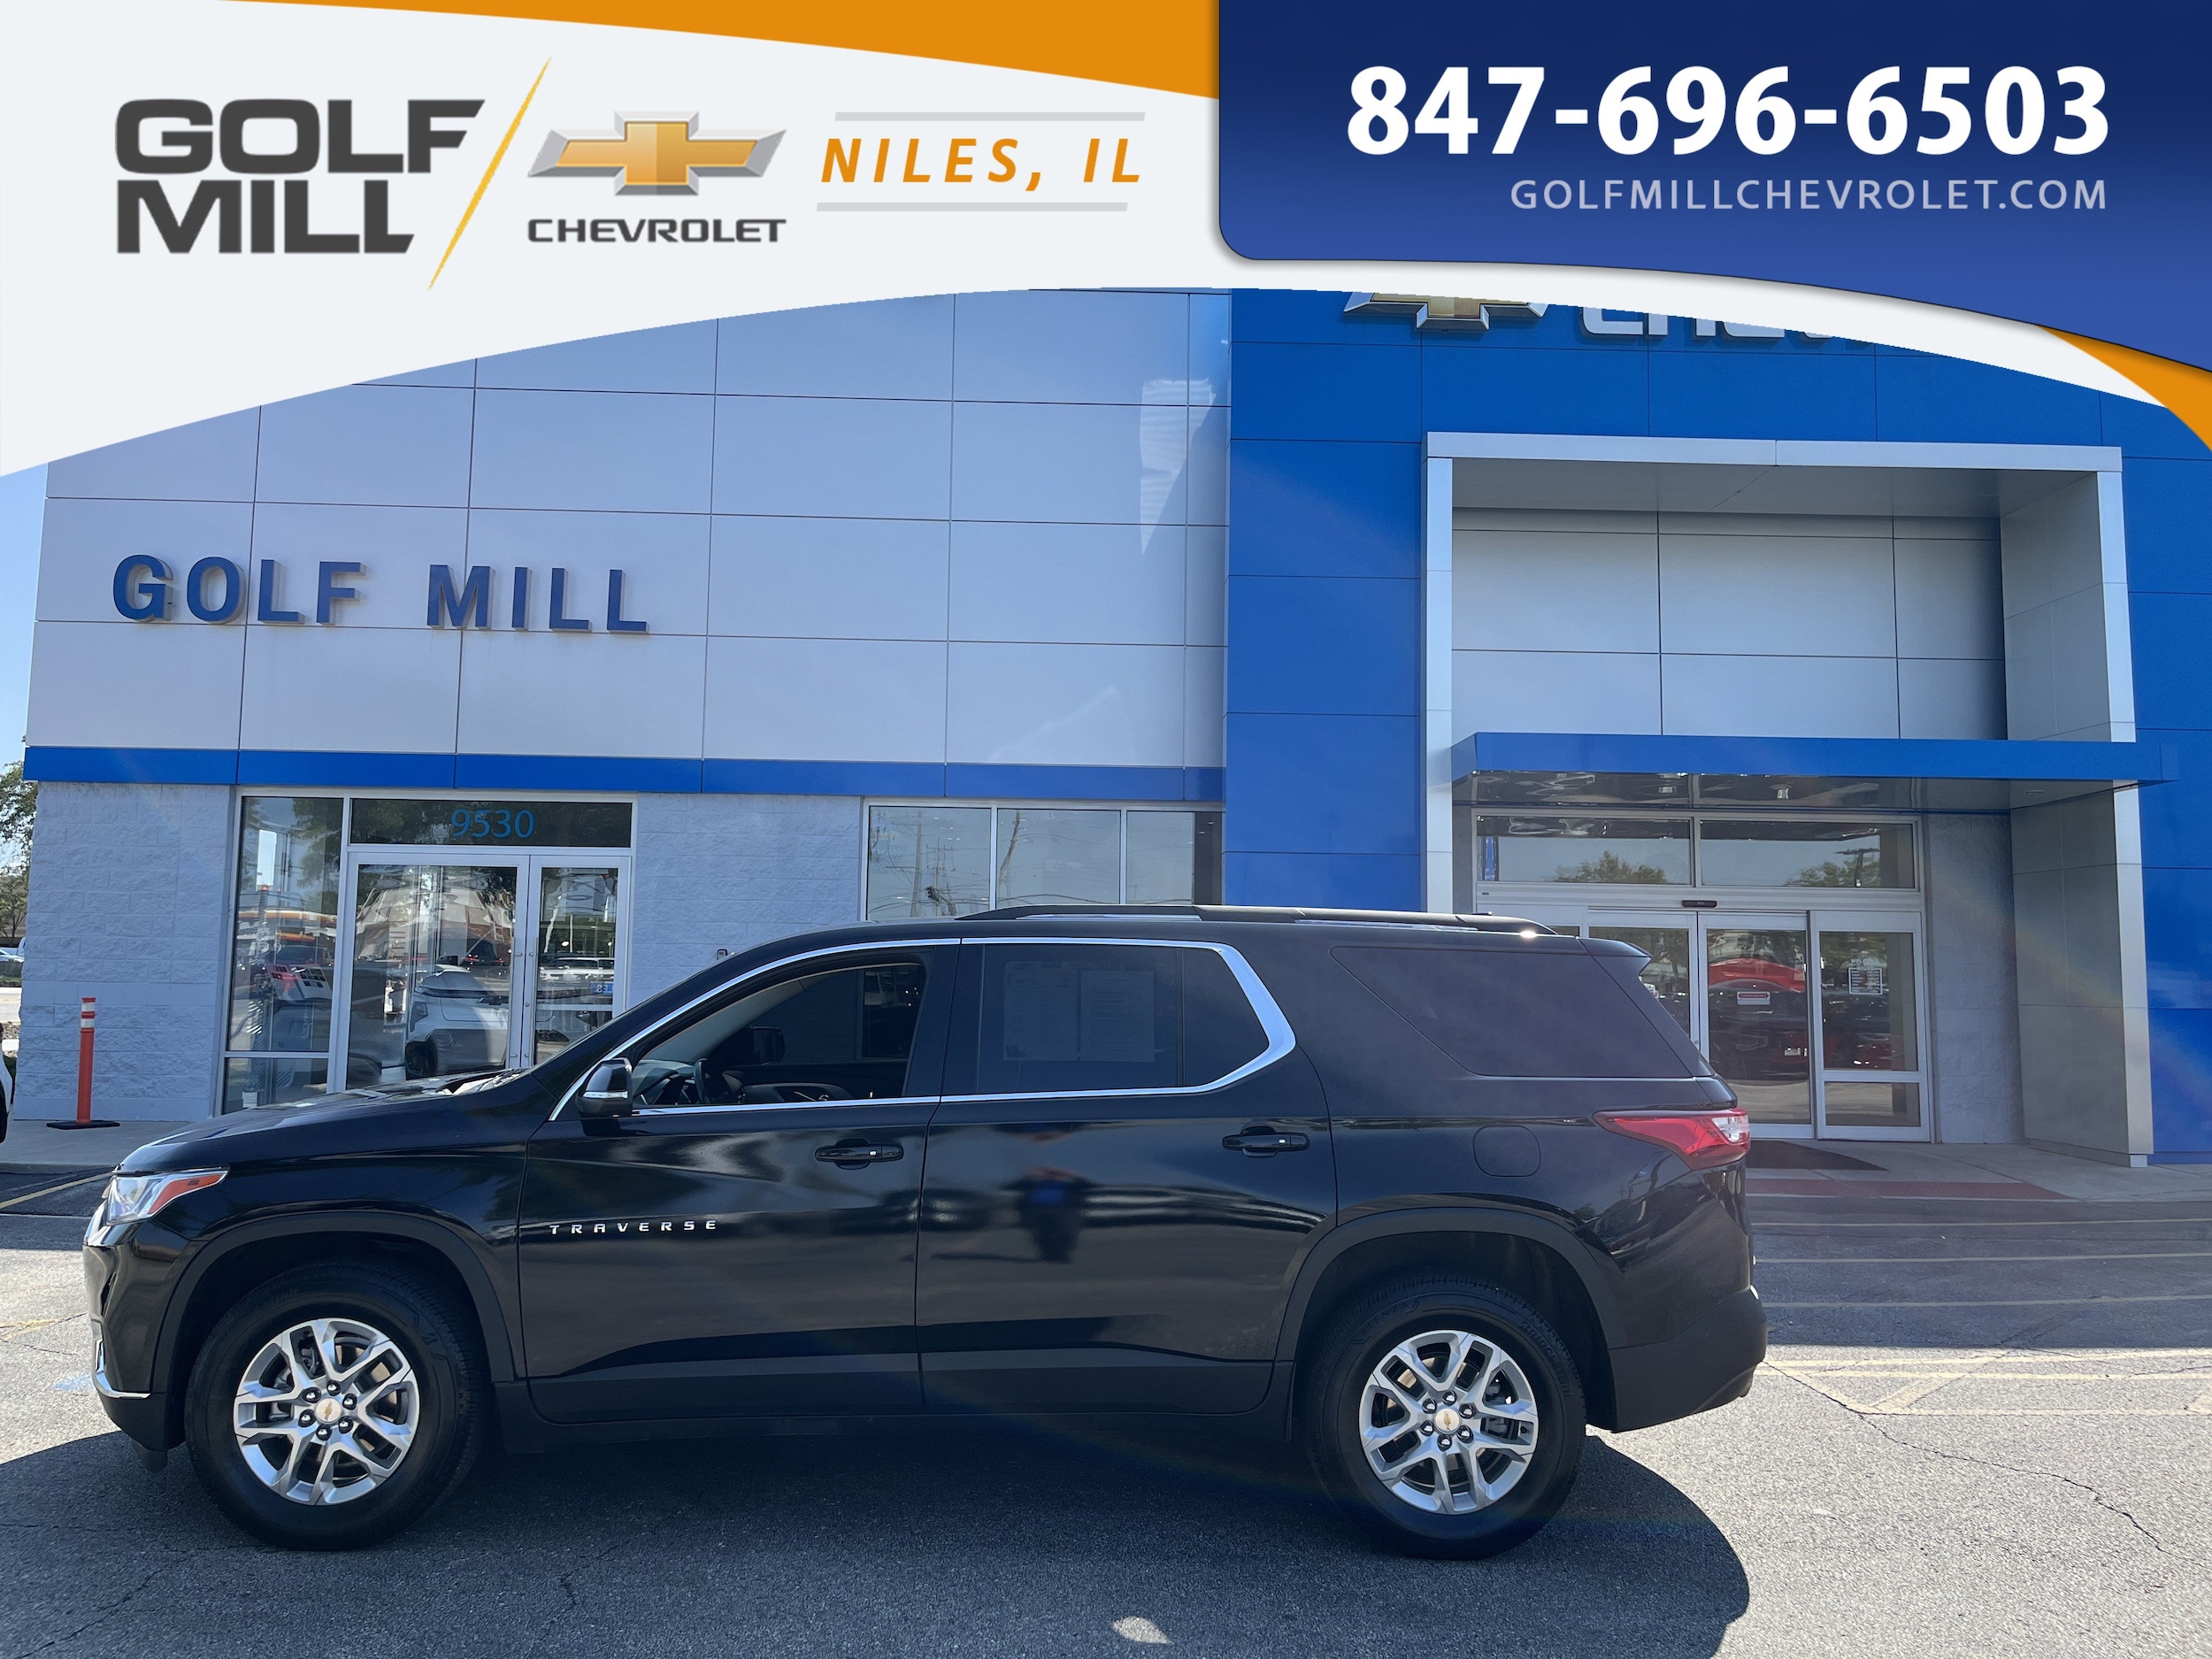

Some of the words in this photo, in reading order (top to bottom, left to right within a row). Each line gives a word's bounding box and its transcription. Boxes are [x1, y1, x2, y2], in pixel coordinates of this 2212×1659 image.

[112, 554, 365, 625] GOLF
[426, 564, 649, 634] MILL
[450, 808, 535, 839] 9530
[549, 1220, 718, 1235] TRAVERSE
